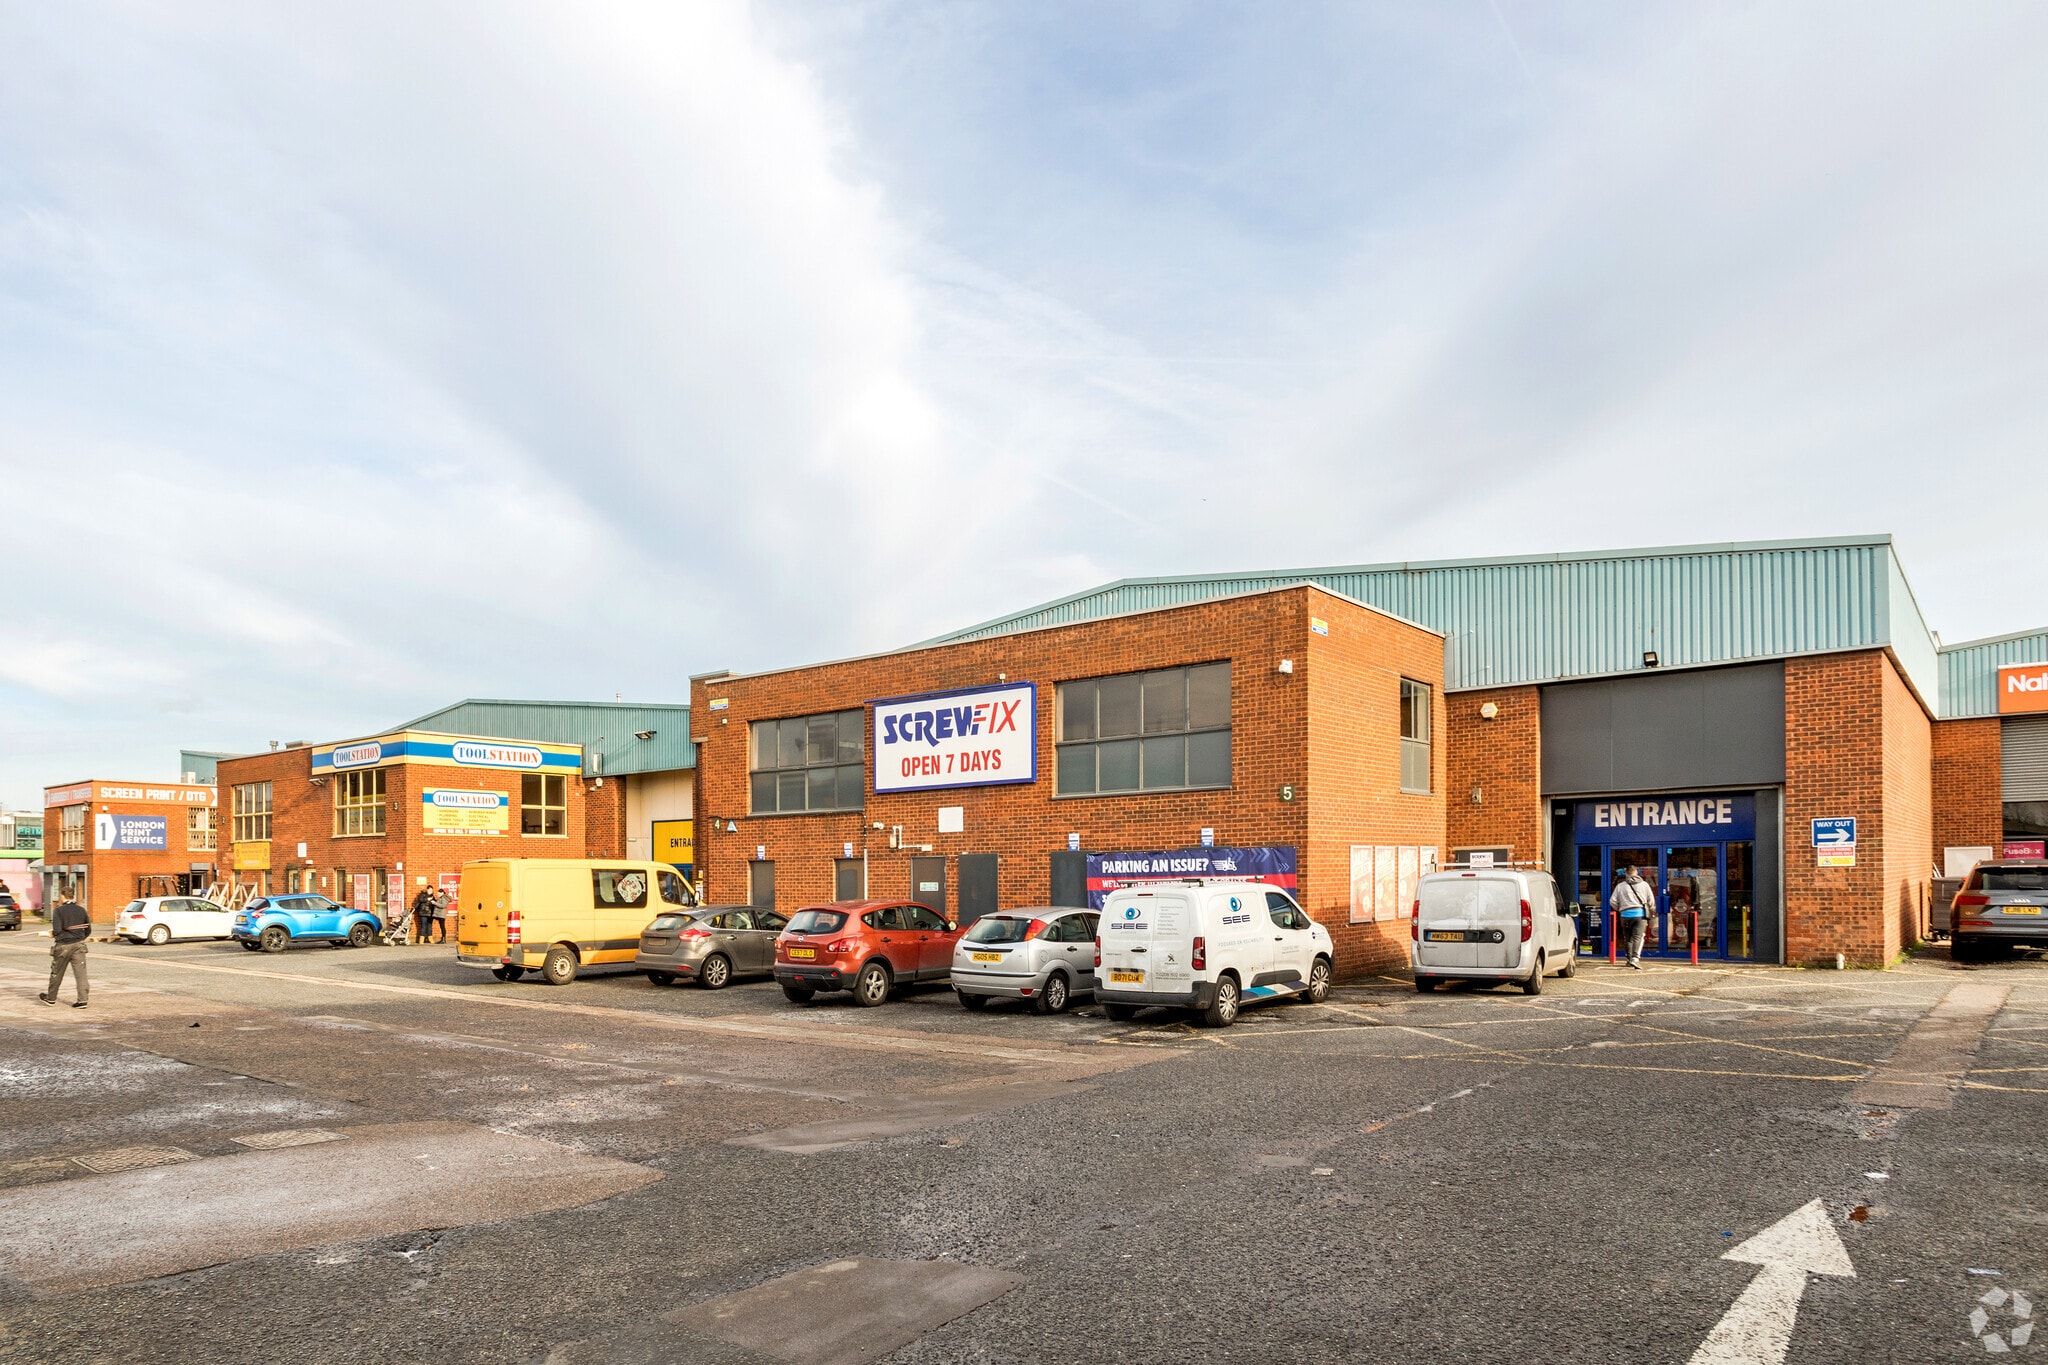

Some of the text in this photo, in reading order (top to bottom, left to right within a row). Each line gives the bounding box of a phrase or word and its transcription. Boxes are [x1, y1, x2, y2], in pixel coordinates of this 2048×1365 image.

[884, 700, 1022, 747] SCREWFIX
[335, 746, 380, 764] TOOLSTATION
[457, 746, 538, 763] TOOLSTATION
[901, 749, 1002, 777] OPEN 7 DAYS
[100, 787, 142, 799] SCREEN
[146, 789, 176, 800] PRINT
[186, 791, 206, 802] DTG
[438, 794, 497, 804] TOOLSTATION
[1282, 786, 1293, 801] 5
[1594, 799, 1732, 828] ENTRANCE
[100, 822, 106, 841] 1
[121, 821, 165, 829] LONDON
[714, 819, 720, 829] 4
[121, 828, 151, 837] PRINT
[121, 836, 163, 844] SERVICE
[1102, 857, 1209, 874] PARKING AN ISSUE?
[1222, 914, 1250, 925] SEE
